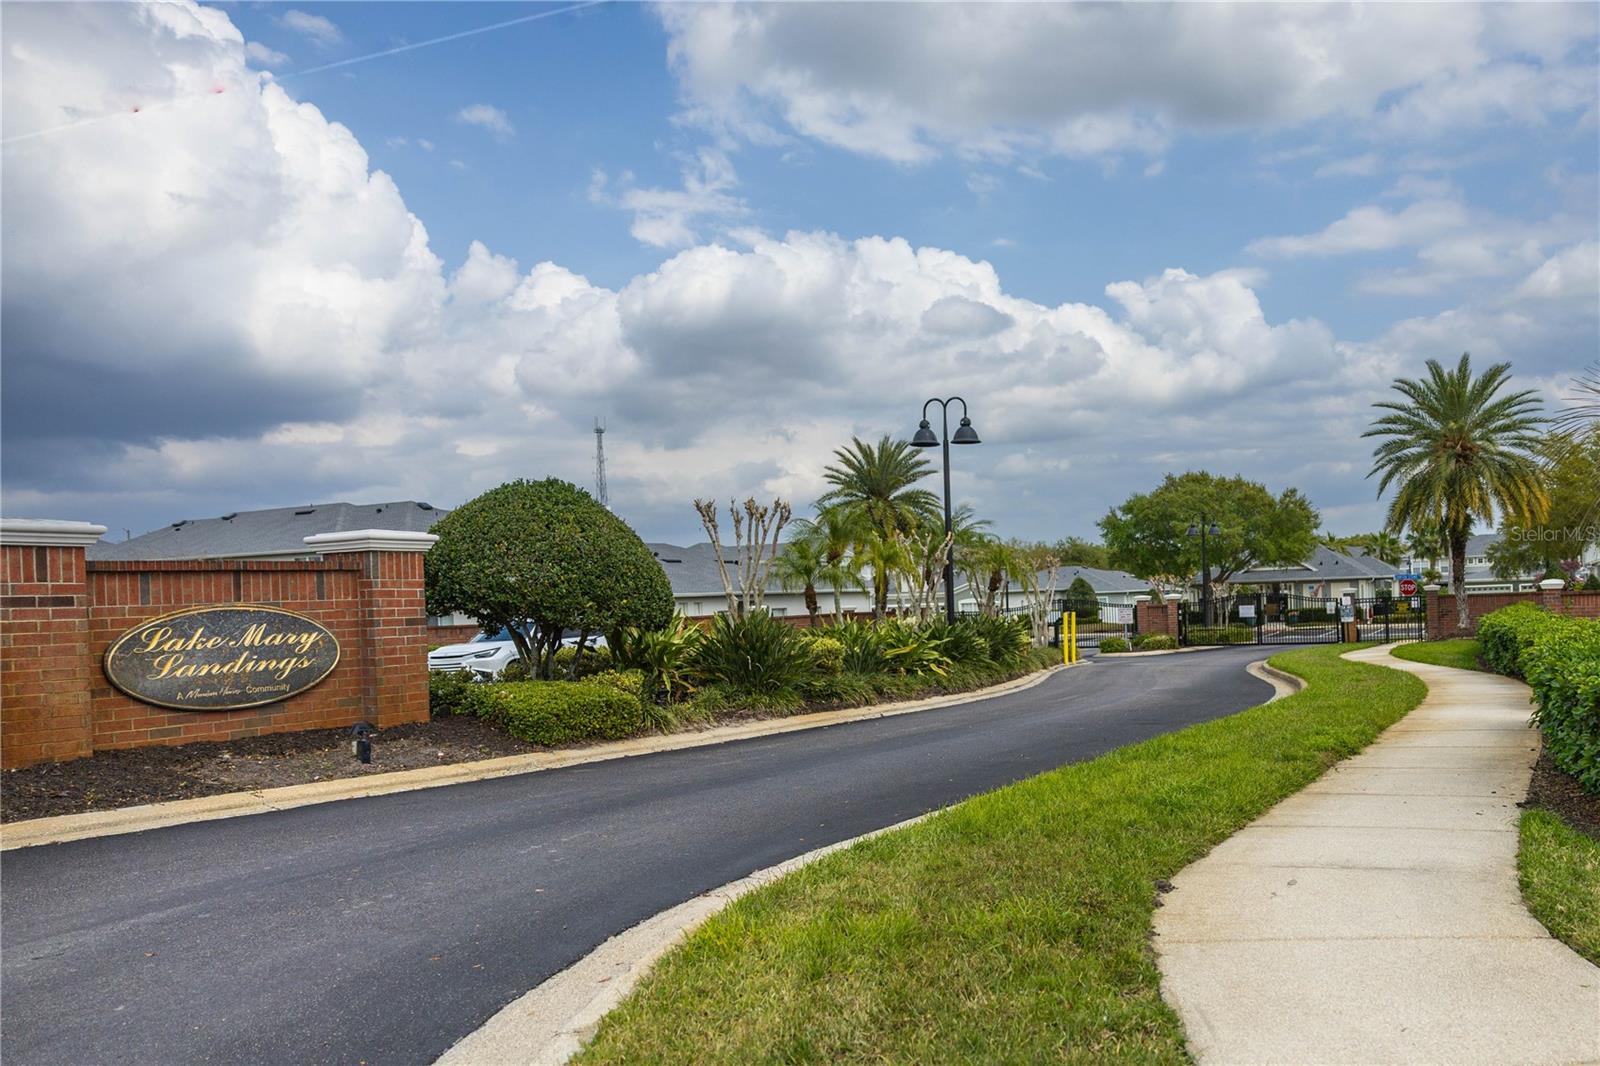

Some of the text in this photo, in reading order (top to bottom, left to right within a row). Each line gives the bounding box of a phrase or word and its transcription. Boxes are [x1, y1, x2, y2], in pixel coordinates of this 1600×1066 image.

[134, 623, 325, 653] Lake Mary
[147, 651, 317, 680] Landings
[176, 691, 184, 700] A
[246, 683, 291, 694] Community
